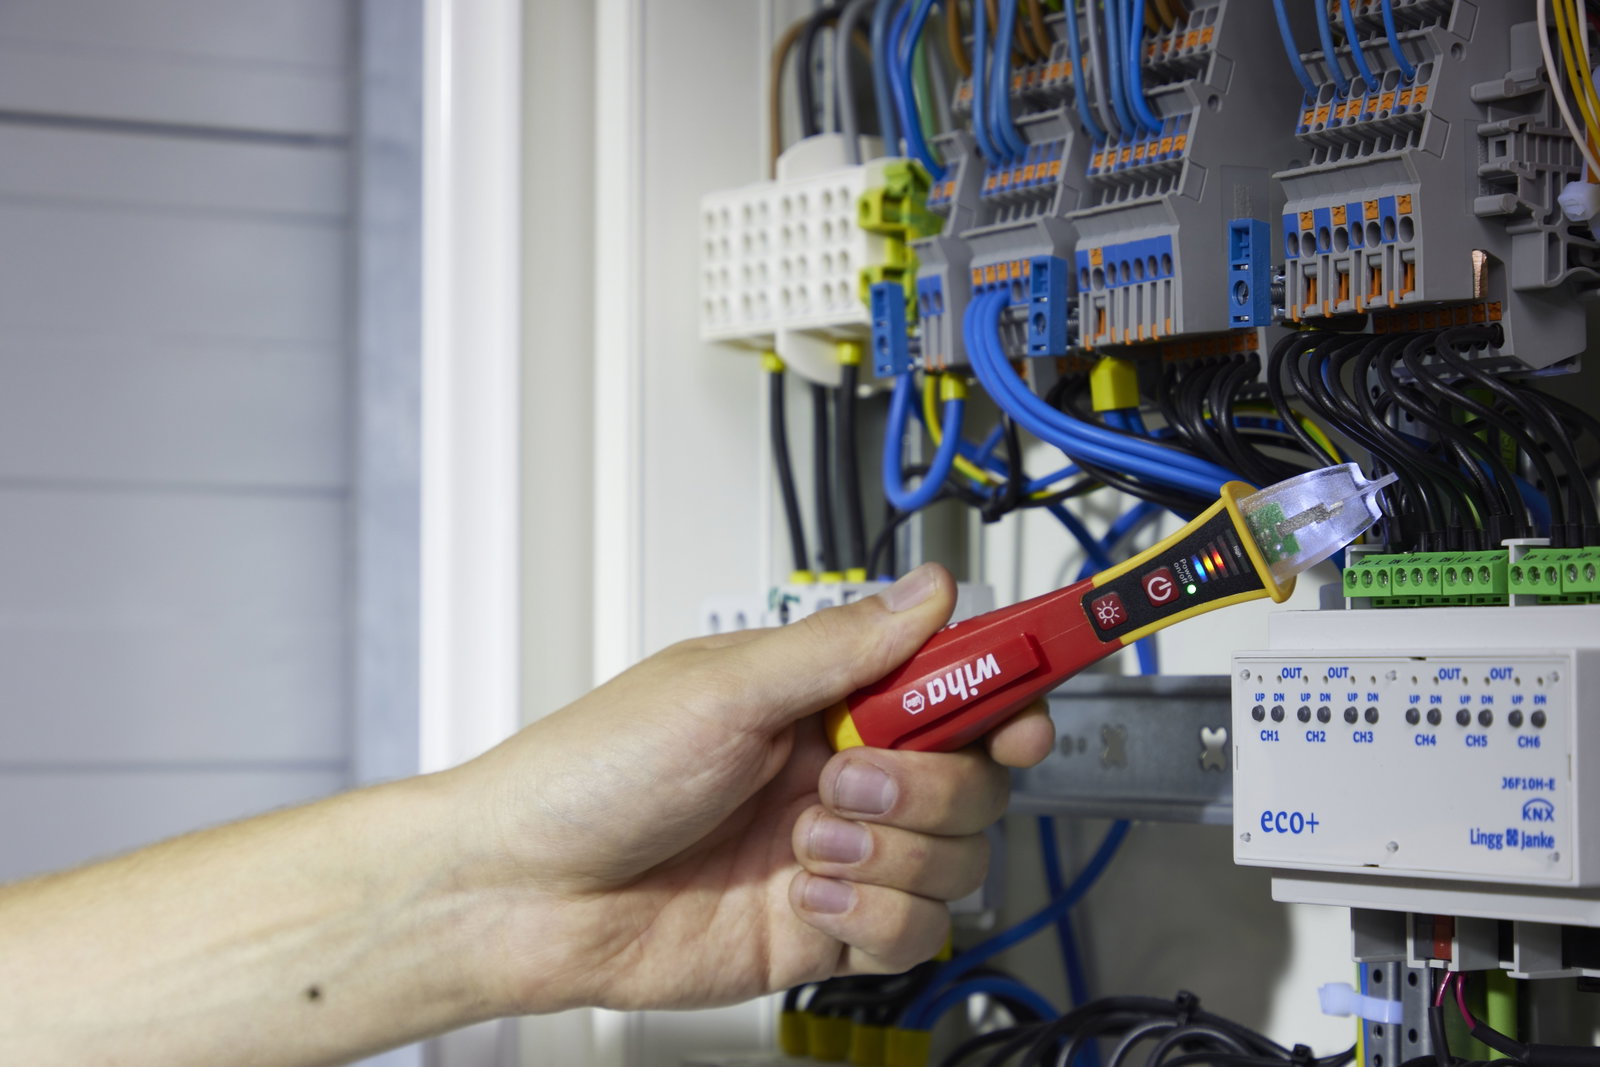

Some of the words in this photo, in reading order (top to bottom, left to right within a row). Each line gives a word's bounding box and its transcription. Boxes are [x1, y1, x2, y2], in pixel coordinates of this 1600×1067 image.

[1173, 562, 1189, 584] on/off
[1179, 558, 1195, 582] Power
[926, 653, 1001, 706] wiha
[1281, 667, 1302, 679] OUT
[1328, 667, 1349, 679] OUT
[1438, 668, 1461, 680] OUT
[1490, 667, 1513, 680] OUT
[1255, 693, 1265, 701] UP
[1274, 693, 1285, 702] DN
[1300, 693, 1311, 702] UP
[1320, 693, 1331, 702] DN
[1347, 693, 1358, 702] UP
[1367, 693, 1379, 702] DN
[1409, 695, 1420, 704] UP
[1430, 695, 1442, 704] DN
[1460, 695, 1471, 704] UP
[1481, 695, 1493, 704] DN
[1512, 695, 1523, 704] UP
[1534, 695, 1546, 704] DN
[1260, 730, 1279, 742] CH1
[1306, 730, 1326, 742] CH2
[1353, 731, 1373, 743] CH3
[1415, 734, 1436, 746] CH4
[1465, 735, 1488, 747] CH5
[1517, 736, 1540, 748] CH6
[1502, 777, 1555, 791] J6F10H-E
[1260, 810, 1319, 834] eco+
[1522, 807, 1554, 822] KNX
[1470, 827, 1503, 850] Lingg
[1521, 830, 1554, 850] Janke
